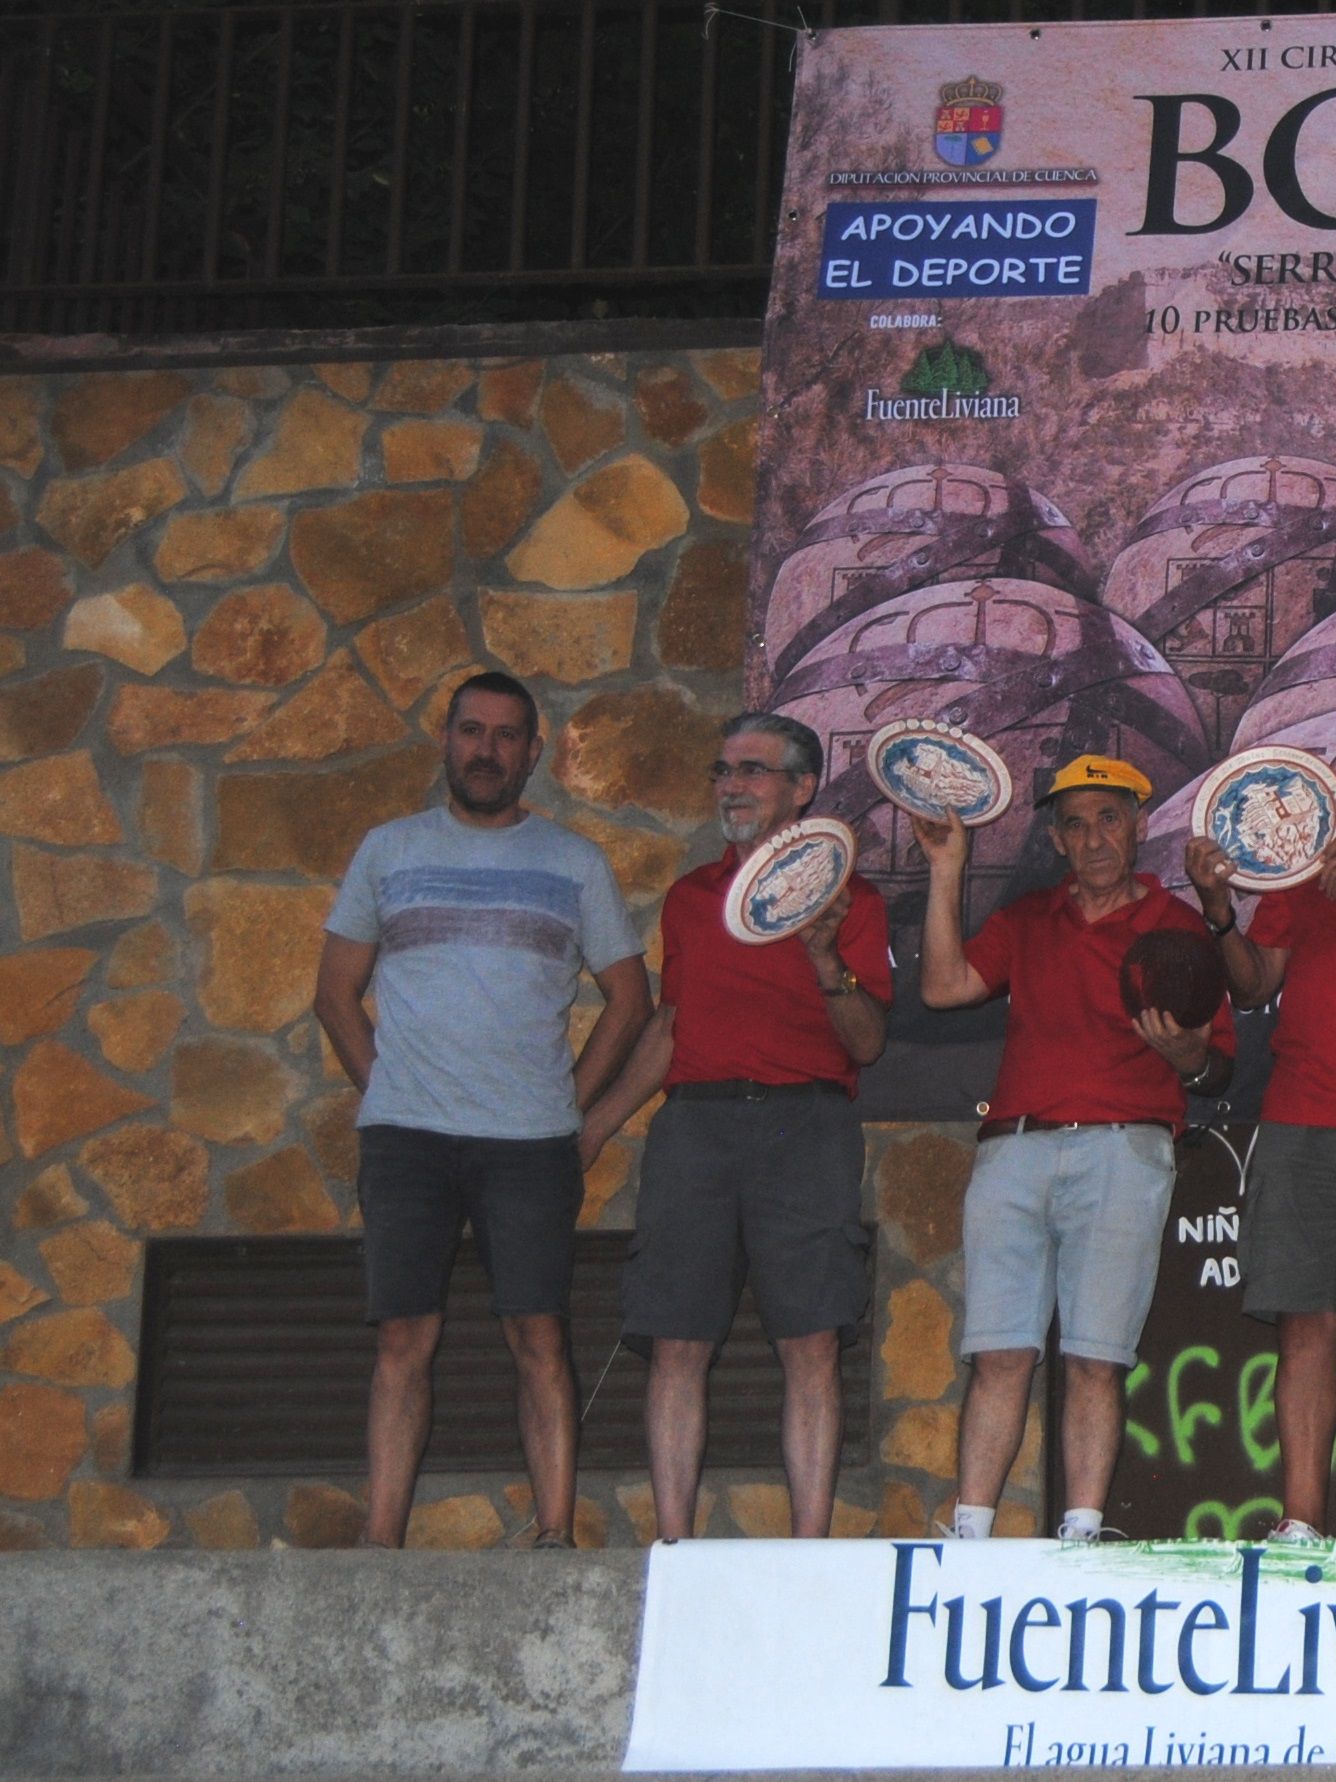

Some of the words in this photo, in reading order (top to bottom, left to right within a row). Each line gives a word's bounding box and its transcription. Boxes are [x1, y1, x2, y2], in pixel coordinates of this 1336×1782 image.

[1220, 47, 1269, 72] XII
[830, 170, 921, 185] DIPUTACIÓN
[922, 169, 1009, 184] PROVINCIAL
[1012, 170, 1031, 183] DE
[1034, 169, 1098, 182] CUENCA
[841, 211, 1076, 241] APOYANDO
[825, 260, 872, 288] EL
[892, 256, 1083, 287] DEPORTE
[870, 314, 943, 329] COLABORA:
[1146, 305, 1181, 334] 10
[865, 388, 1021, 420] FuenteLiviana
[1003, 1720, 1035, 1767] El
[1045, 1741, 1129, 1767] agua
[1144, 1726, 1271, 1767] Liviana
[1283, 1724, 1325, 1765] de
